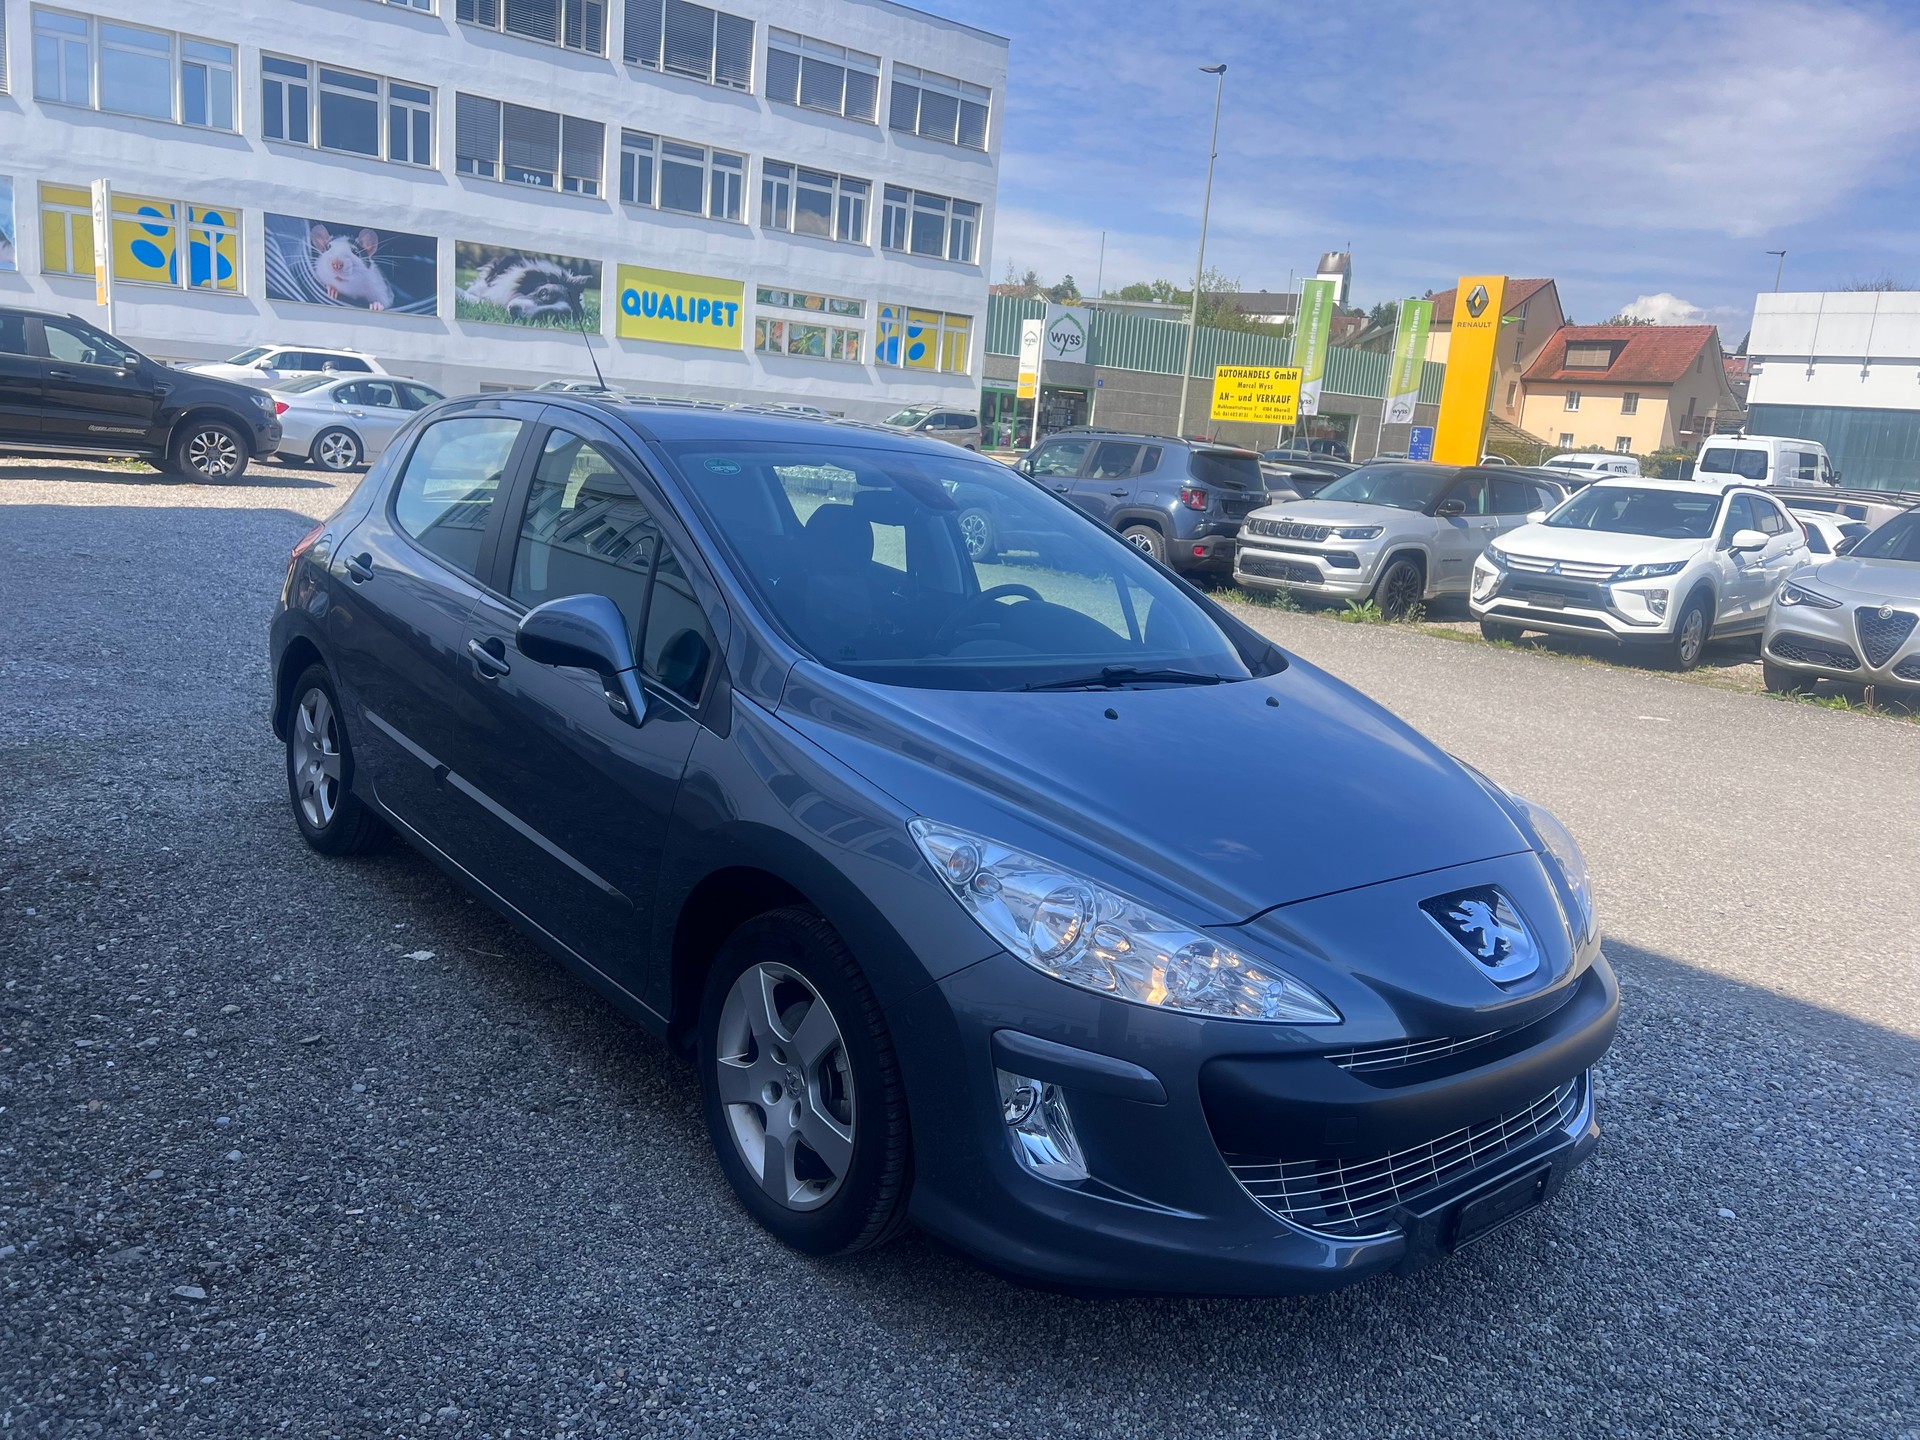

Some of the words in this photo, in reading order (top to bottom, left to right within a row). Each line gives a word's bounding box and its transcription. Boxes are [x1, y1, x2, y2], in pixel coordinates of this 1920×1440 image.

[621, 288, 739, 328] QUALIPET
[1051, 331, 1081, 356] wyss
[1218, 369, 1270, 380] AUTOHANDELS
[1274, 371, 1297, 380] GmbH
[1238, 393, 1252, 402] und
[1256, 394, 1291, 404] VERKAUF
[1392, 409, 1408, 419] wyss
